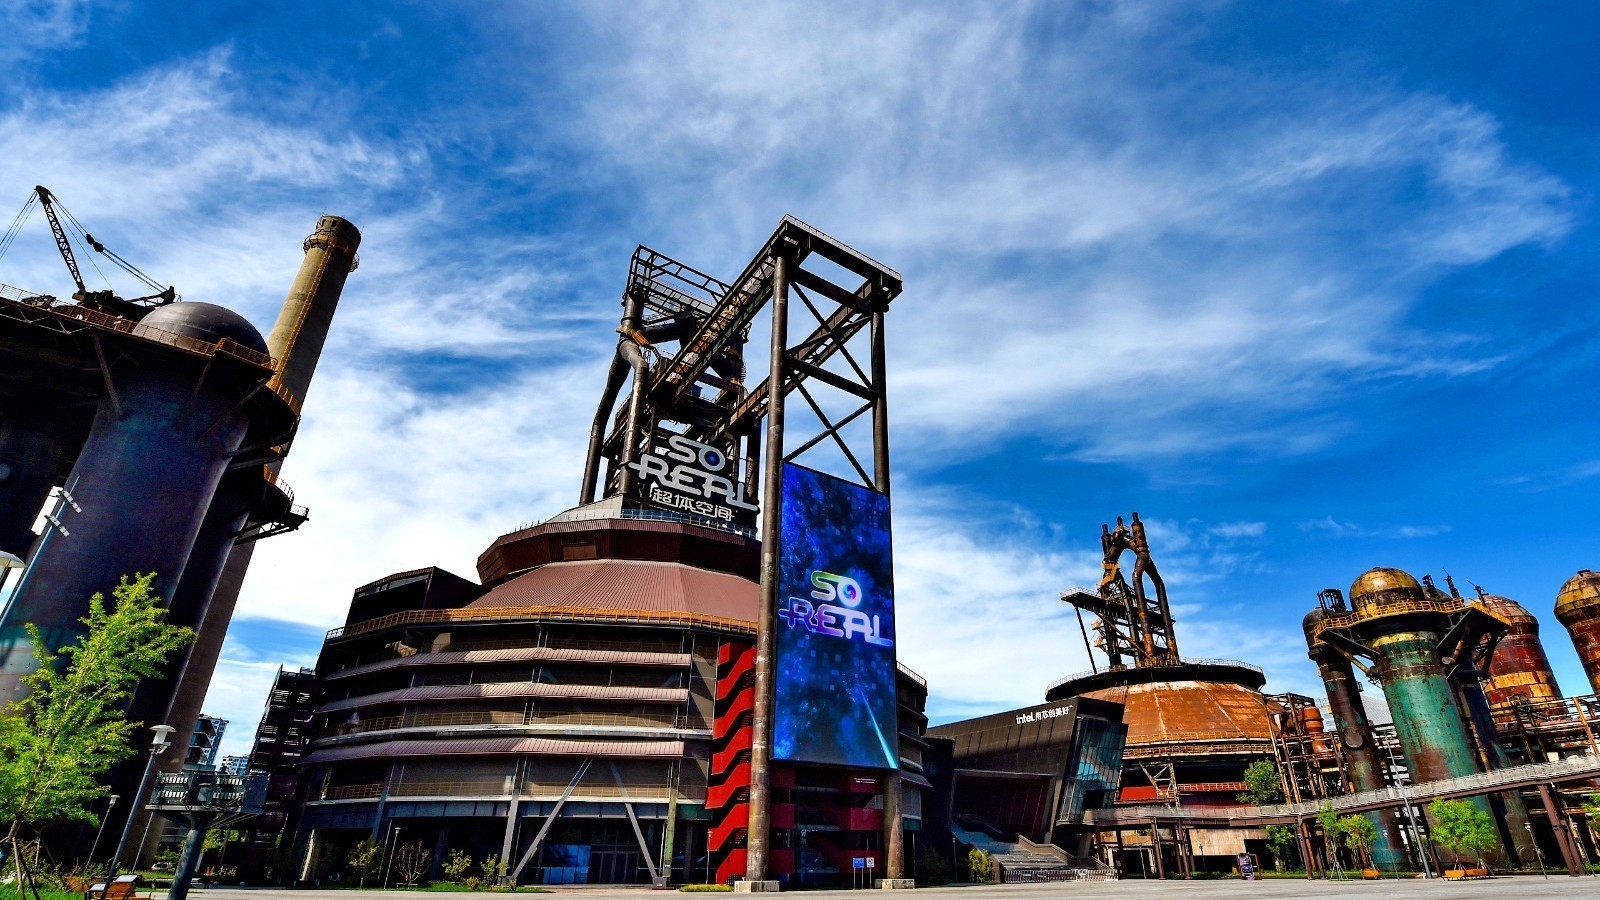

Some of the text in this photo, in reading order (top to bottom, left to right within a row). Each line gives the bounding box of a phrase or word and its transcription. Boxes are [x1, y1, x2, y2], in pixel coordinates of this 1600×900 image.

[668, 434, 726, 472] SO
[628, 453, 758, 512] REAL
[651, 488, 736, 521] 超体空间
[811, 570, 862, 607] SO
[778, 597, 893, 647] REAL
